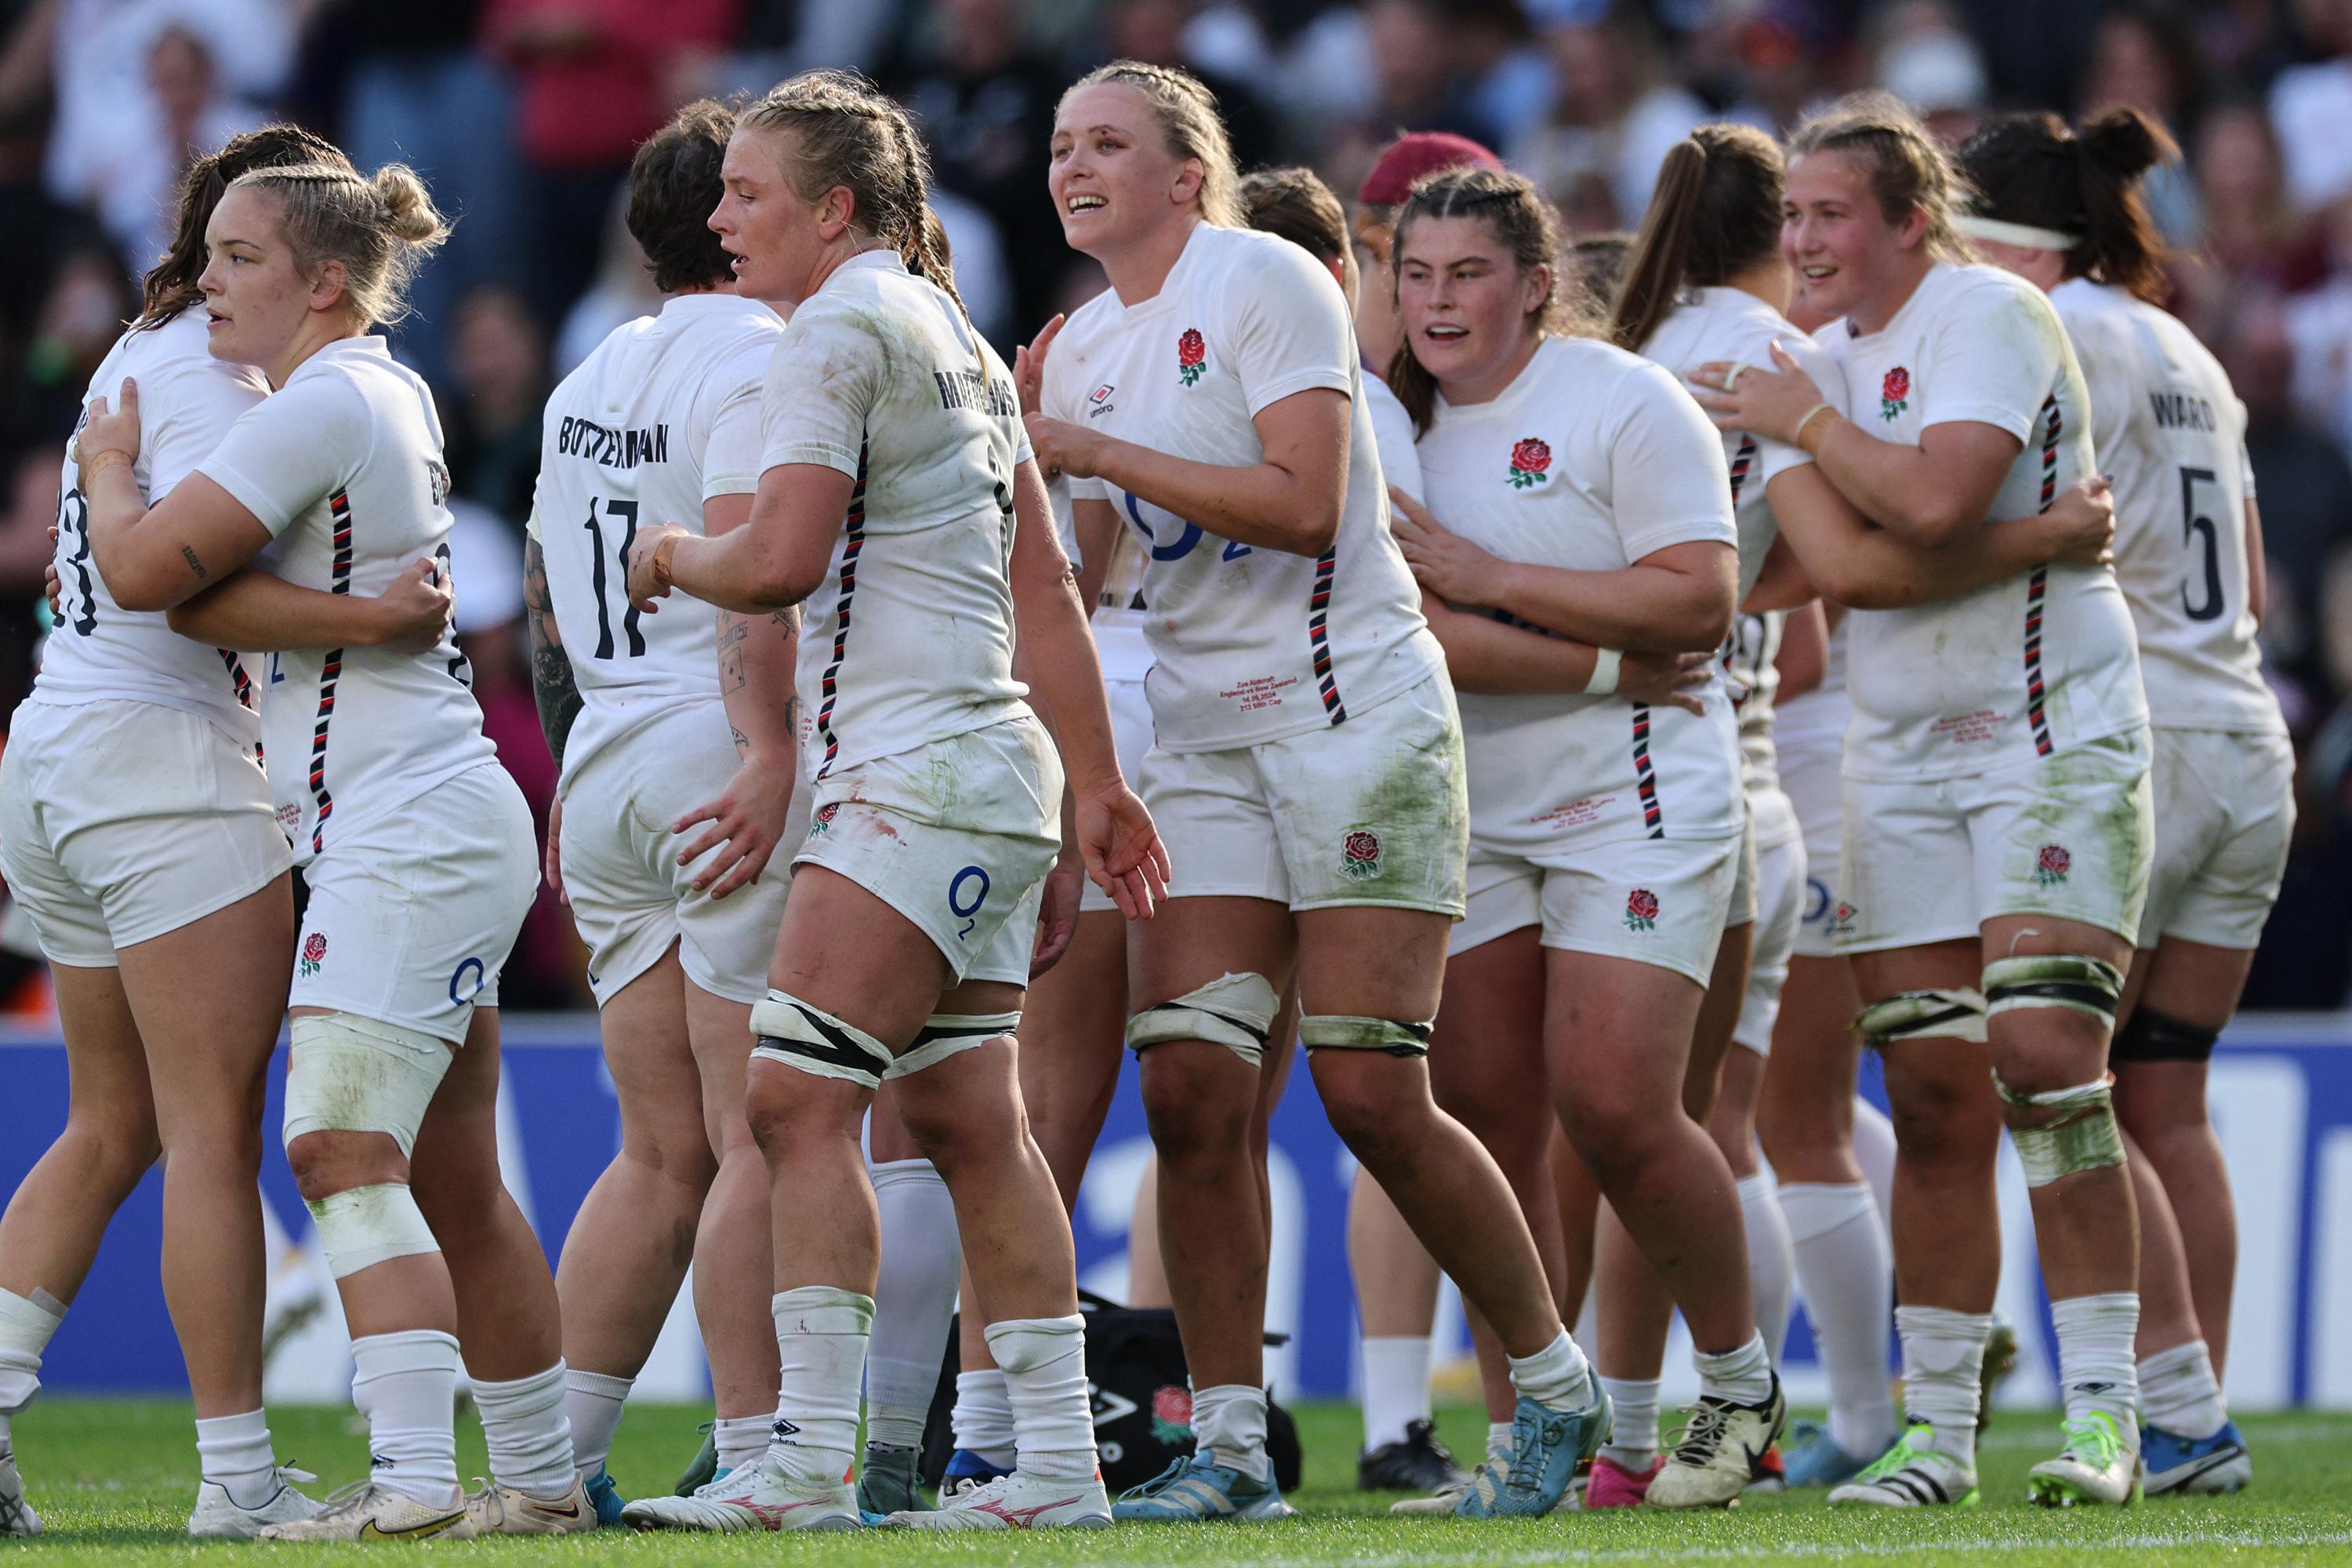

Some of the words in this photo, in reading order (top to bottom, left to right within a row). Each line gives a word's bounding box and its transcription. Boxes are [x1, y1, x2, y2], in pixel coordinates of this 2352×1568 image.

[1090, 404, 1114, 419] umbro
[2151, 393, 2216, 432] WARD
[2179, 466, 2224, 622] 5
[584, 496, 646, 660] 17
[1220, 690, 1245, 699] England
[1270, 677, 1298, 689] Zealand
